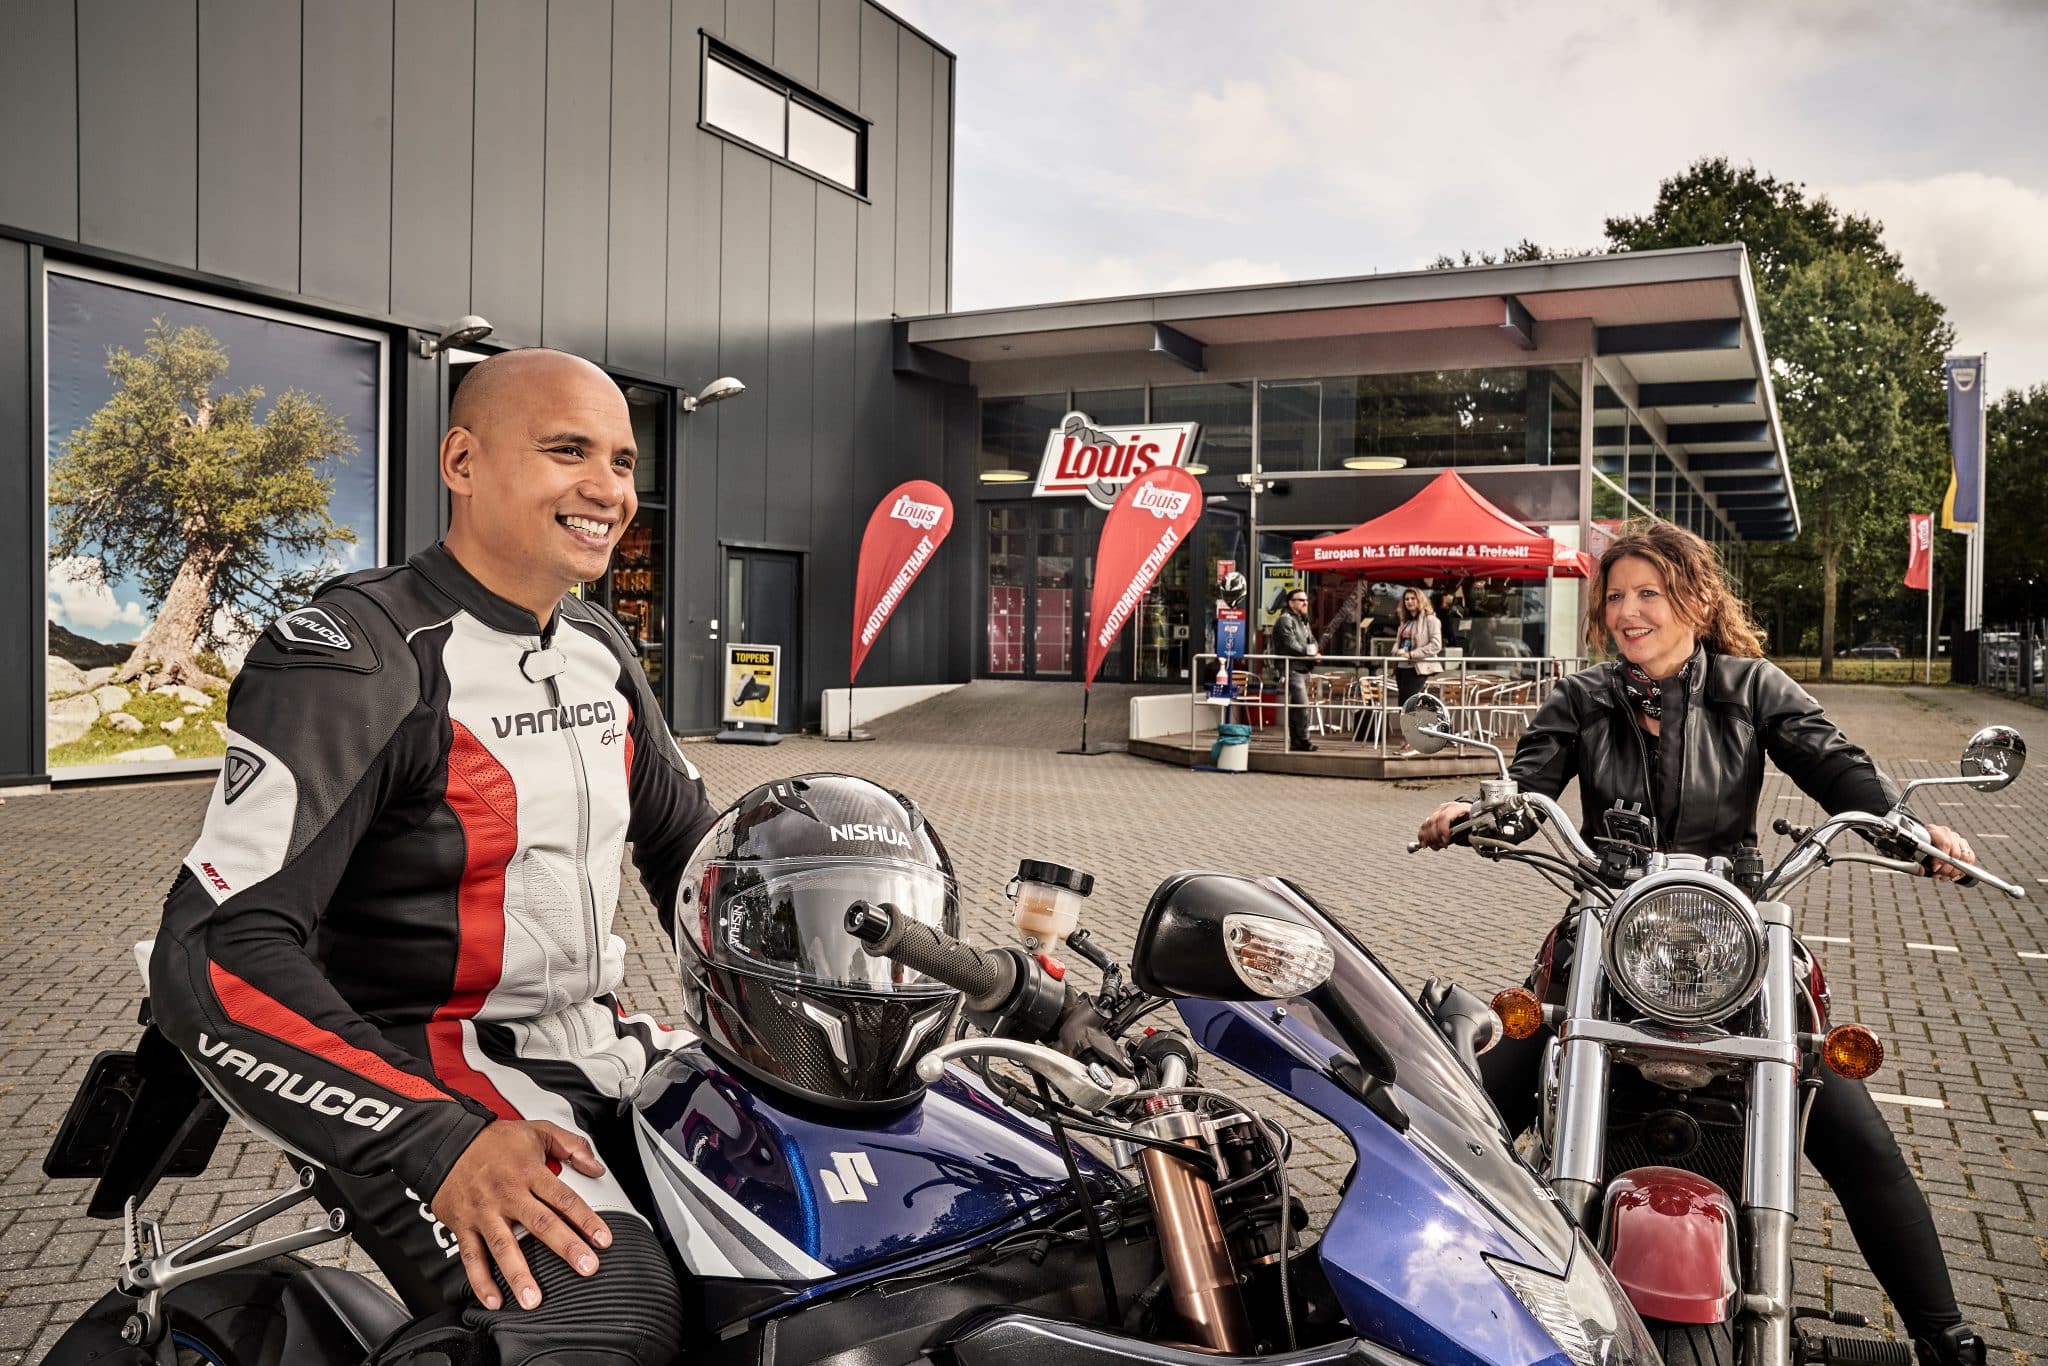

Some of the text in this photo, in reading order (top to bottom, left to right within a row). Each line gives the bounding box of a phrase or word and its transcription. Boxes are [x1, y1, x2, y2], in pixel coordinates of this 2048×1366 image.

[1056, 435, 1161, 480] Louis
[898, 502, 936, 523] Louis
[1140, 487, 1183, 511] Louis
[1314, 547, 1360, 562] Europas
[1362, 545, 1386, 559] Nr.1
[1388, 544, 1406, 557] für
[1408, 544, 1463, 557] Motorrad
[1466, 545, 1477, 557] &
[861, 535, 935, 646] #MOTORINHETHART
[1098, 525, 1179, 648] #MOTORINHETHART
[736, 652, 770, 663] TOPPERS
[491, 700, 616, 739] VANUCCI
[829, 823, 913, 850] NISHUA
[730, 904, 744, 945] NISHUA
[199, 1032, 404, 1132] VANUCCI
